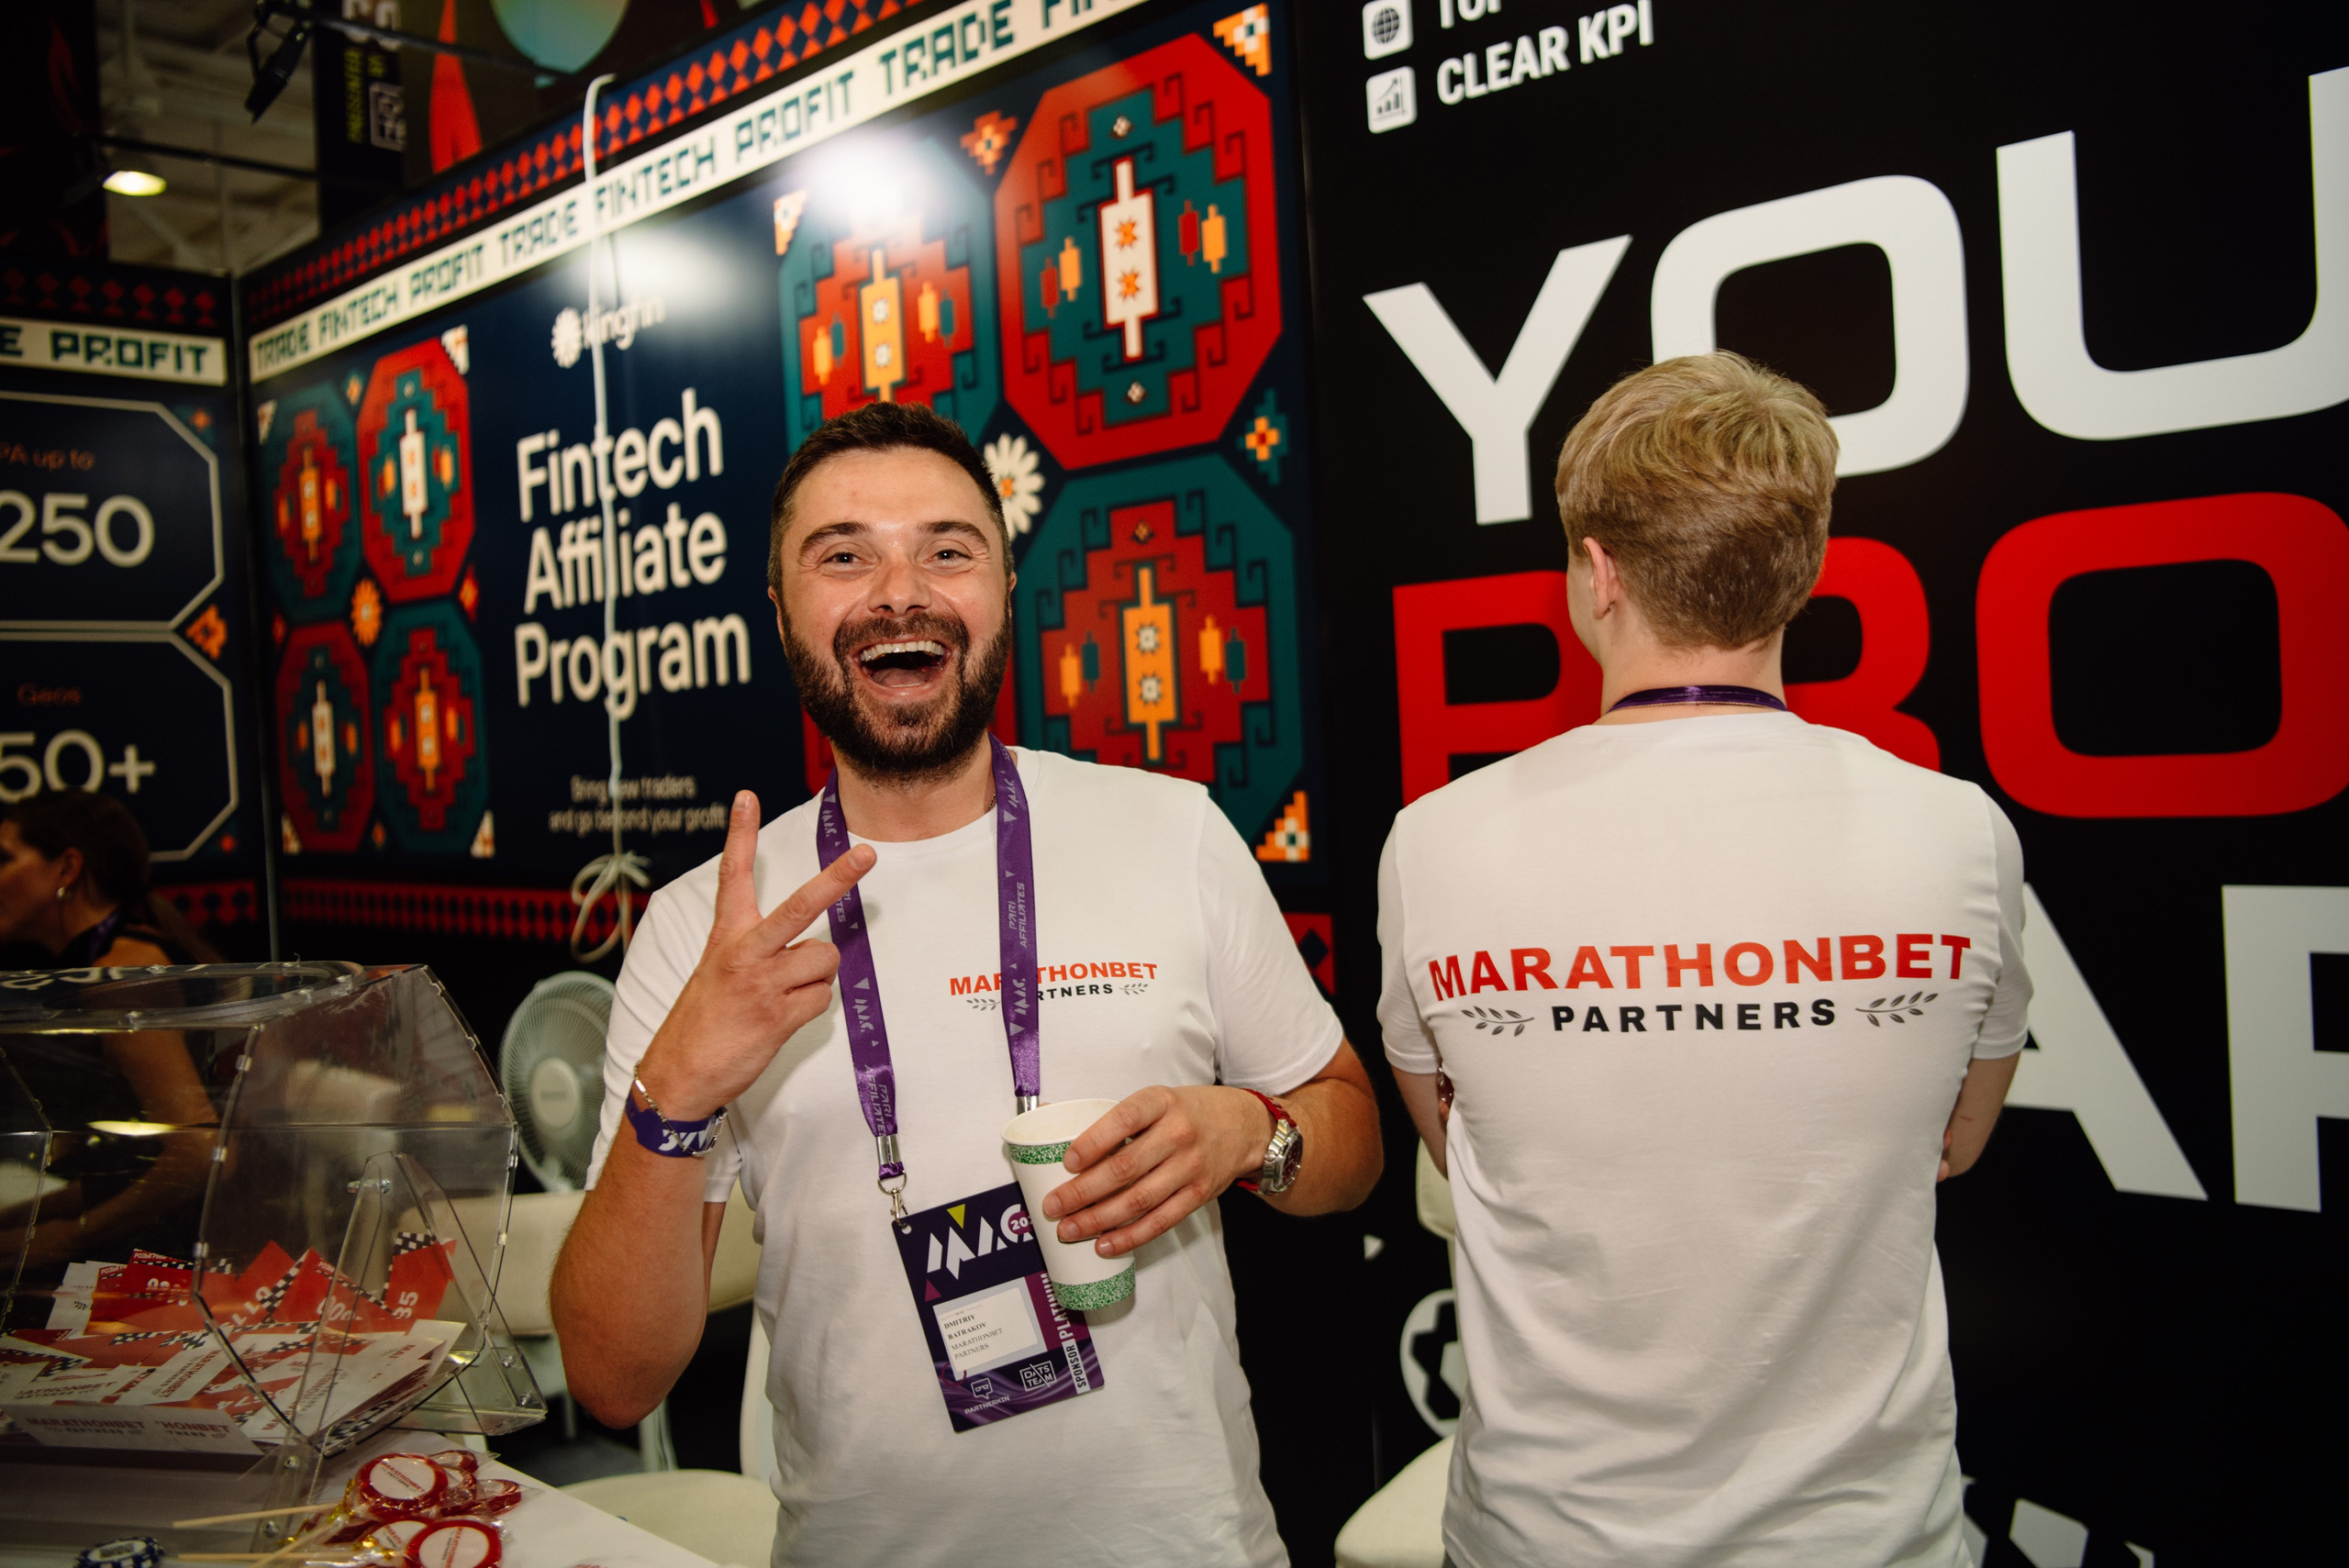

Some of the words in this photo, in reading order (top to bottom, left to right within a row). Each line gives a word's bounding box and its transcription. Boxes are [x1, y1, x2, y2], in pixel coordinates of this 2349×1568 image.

[1437, 26, 1571, 105] CLEAR
[1578, 0, 1653, 64] KPI
[256, 321, 309, 367] TRADE
[320, 282, 397, 343] FINTECH
[411, 244, 484, 297] PROFIT
[499, 200, 578, 258] TRADE
[596, 135, 716, 219] FINTECH
[735, 71, 853, 162] PROFIT
[878, 0, 1014, 95] TRADE
[50, 330, 207, 373] PROFIT
[517, 387, 724, 523] Fintech
[0, 490, 154, 568] 250
[515, 614, 751, 721] Program
[1428, 933, 1972, 1002] MARATHONBET
[1552, 998, 1836, 1033] PARTNERS
[864, 1063, 887, 1137] AFFILIATE
[1010, 1217, 1033, 1230] 20
[943, 1314, 975, 1329] DMITRIY
[947, 1321, 987, 1340] BATRAKOV
[951, 1328, 1003, 1351] MARATHONBET
[953, 1343, 989, 1360] PARTNERS
[1065, 1344, 1086, 1388] SPONSOR
[26, 1418, 146, 1429] MARATHONBET
[964, 1395, 1010, 1415] PARTNERKIN
[155, 1420, 230, 1433] HONBET
